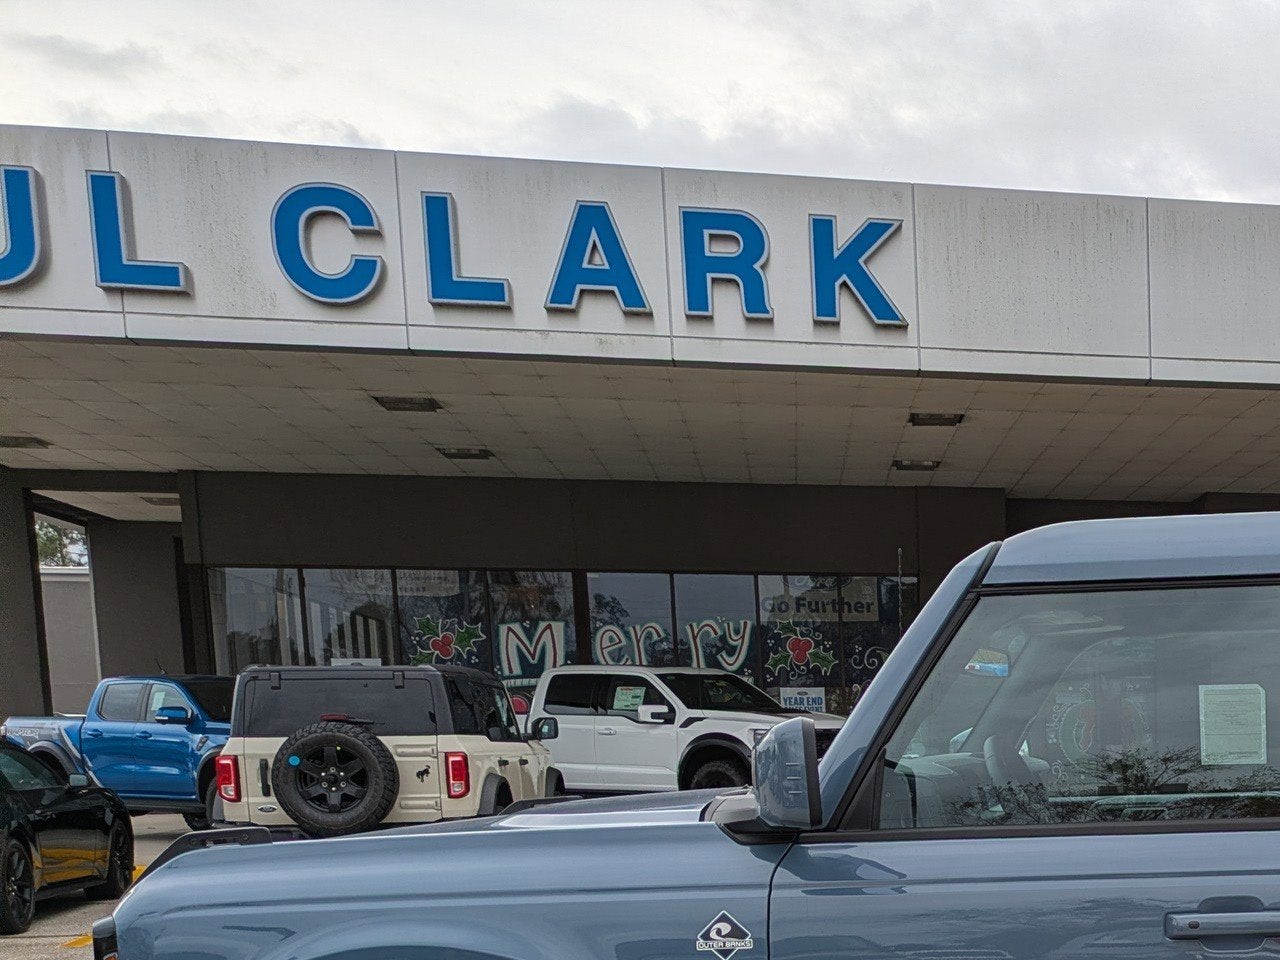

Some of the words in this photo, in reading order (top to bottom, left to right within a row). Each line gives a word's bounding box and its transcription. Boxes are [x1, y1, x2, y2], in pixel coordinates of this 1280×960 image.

[270, 181, 909, 327] CLARK
[761, 595, 790, 613] Go
[795, 595, 875, 614] Further
[498, 619, 752, 676] Merry
[783, 696, 804, 706] YEAR
[806, 696, 823, 706] END
[698, 940, 723, 949] OUTER
[725, 940, 751, 949] BANKS
